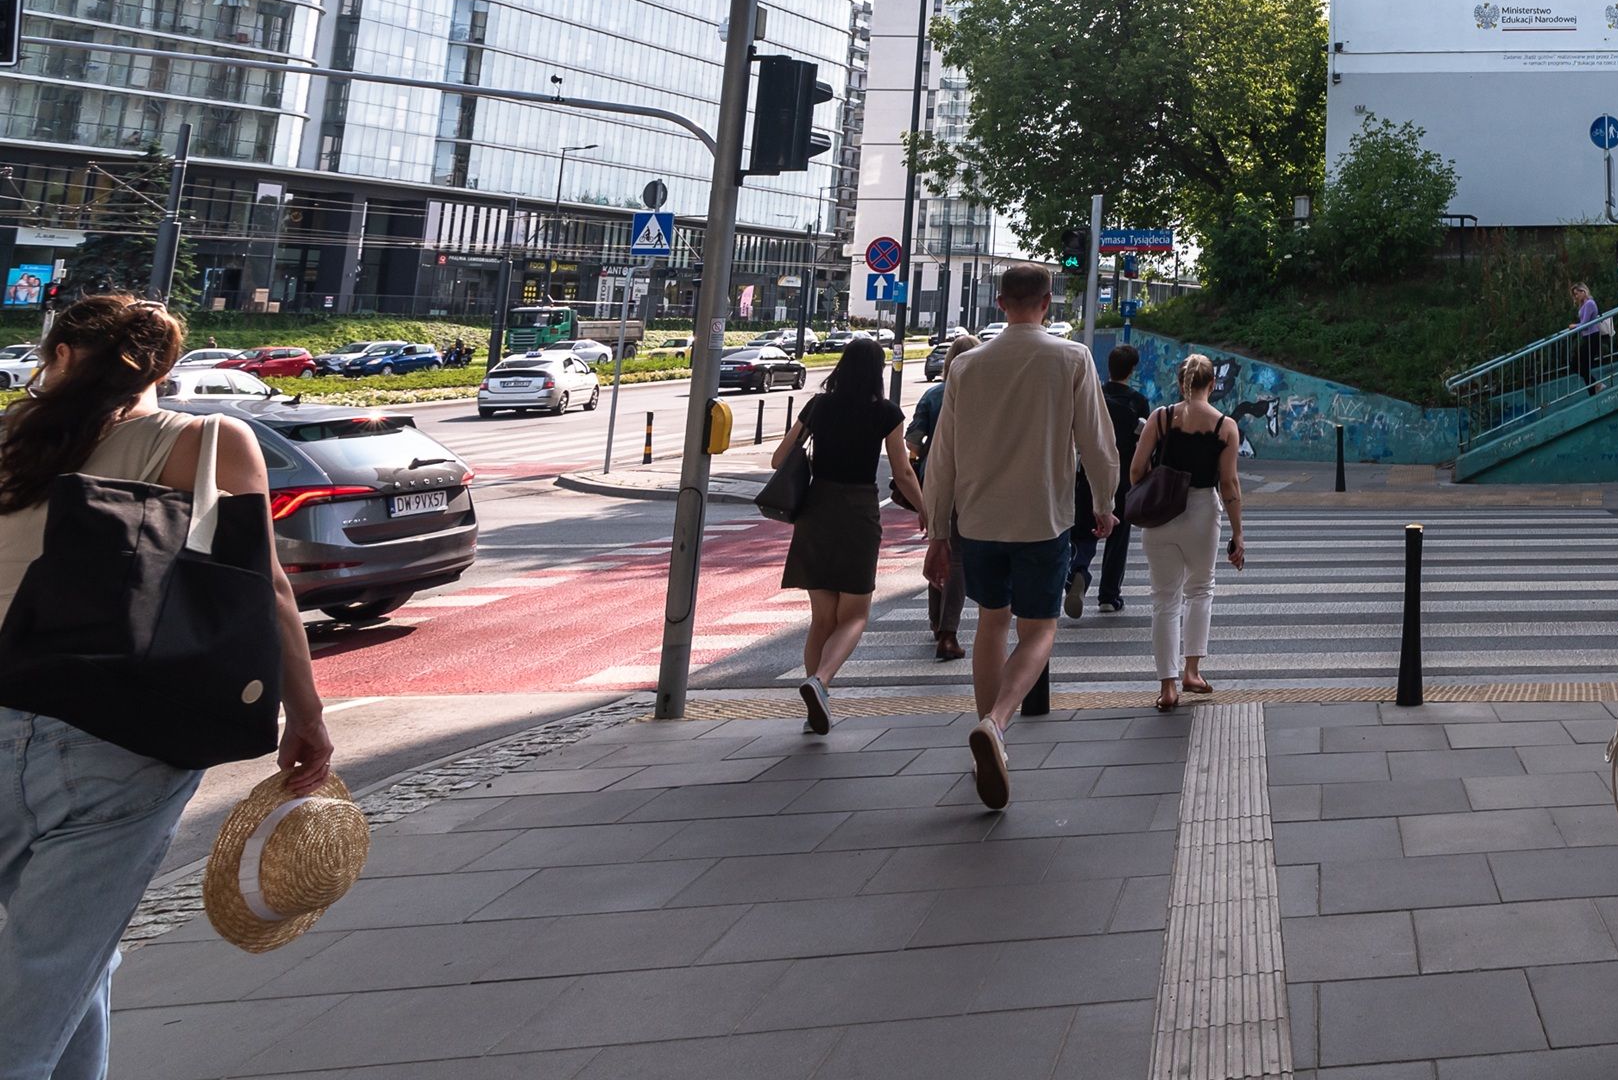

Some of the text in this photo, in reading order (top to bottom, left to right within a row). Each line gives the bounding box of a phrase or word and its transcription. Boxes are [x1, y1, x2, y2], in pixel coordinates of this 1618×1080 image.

[1501, 6, 1552, 15] Ministerstwo
[1501, 15, 1577, 25] Edukacji Narodowej
[396, 492, 445, 512] DW 9VX57
